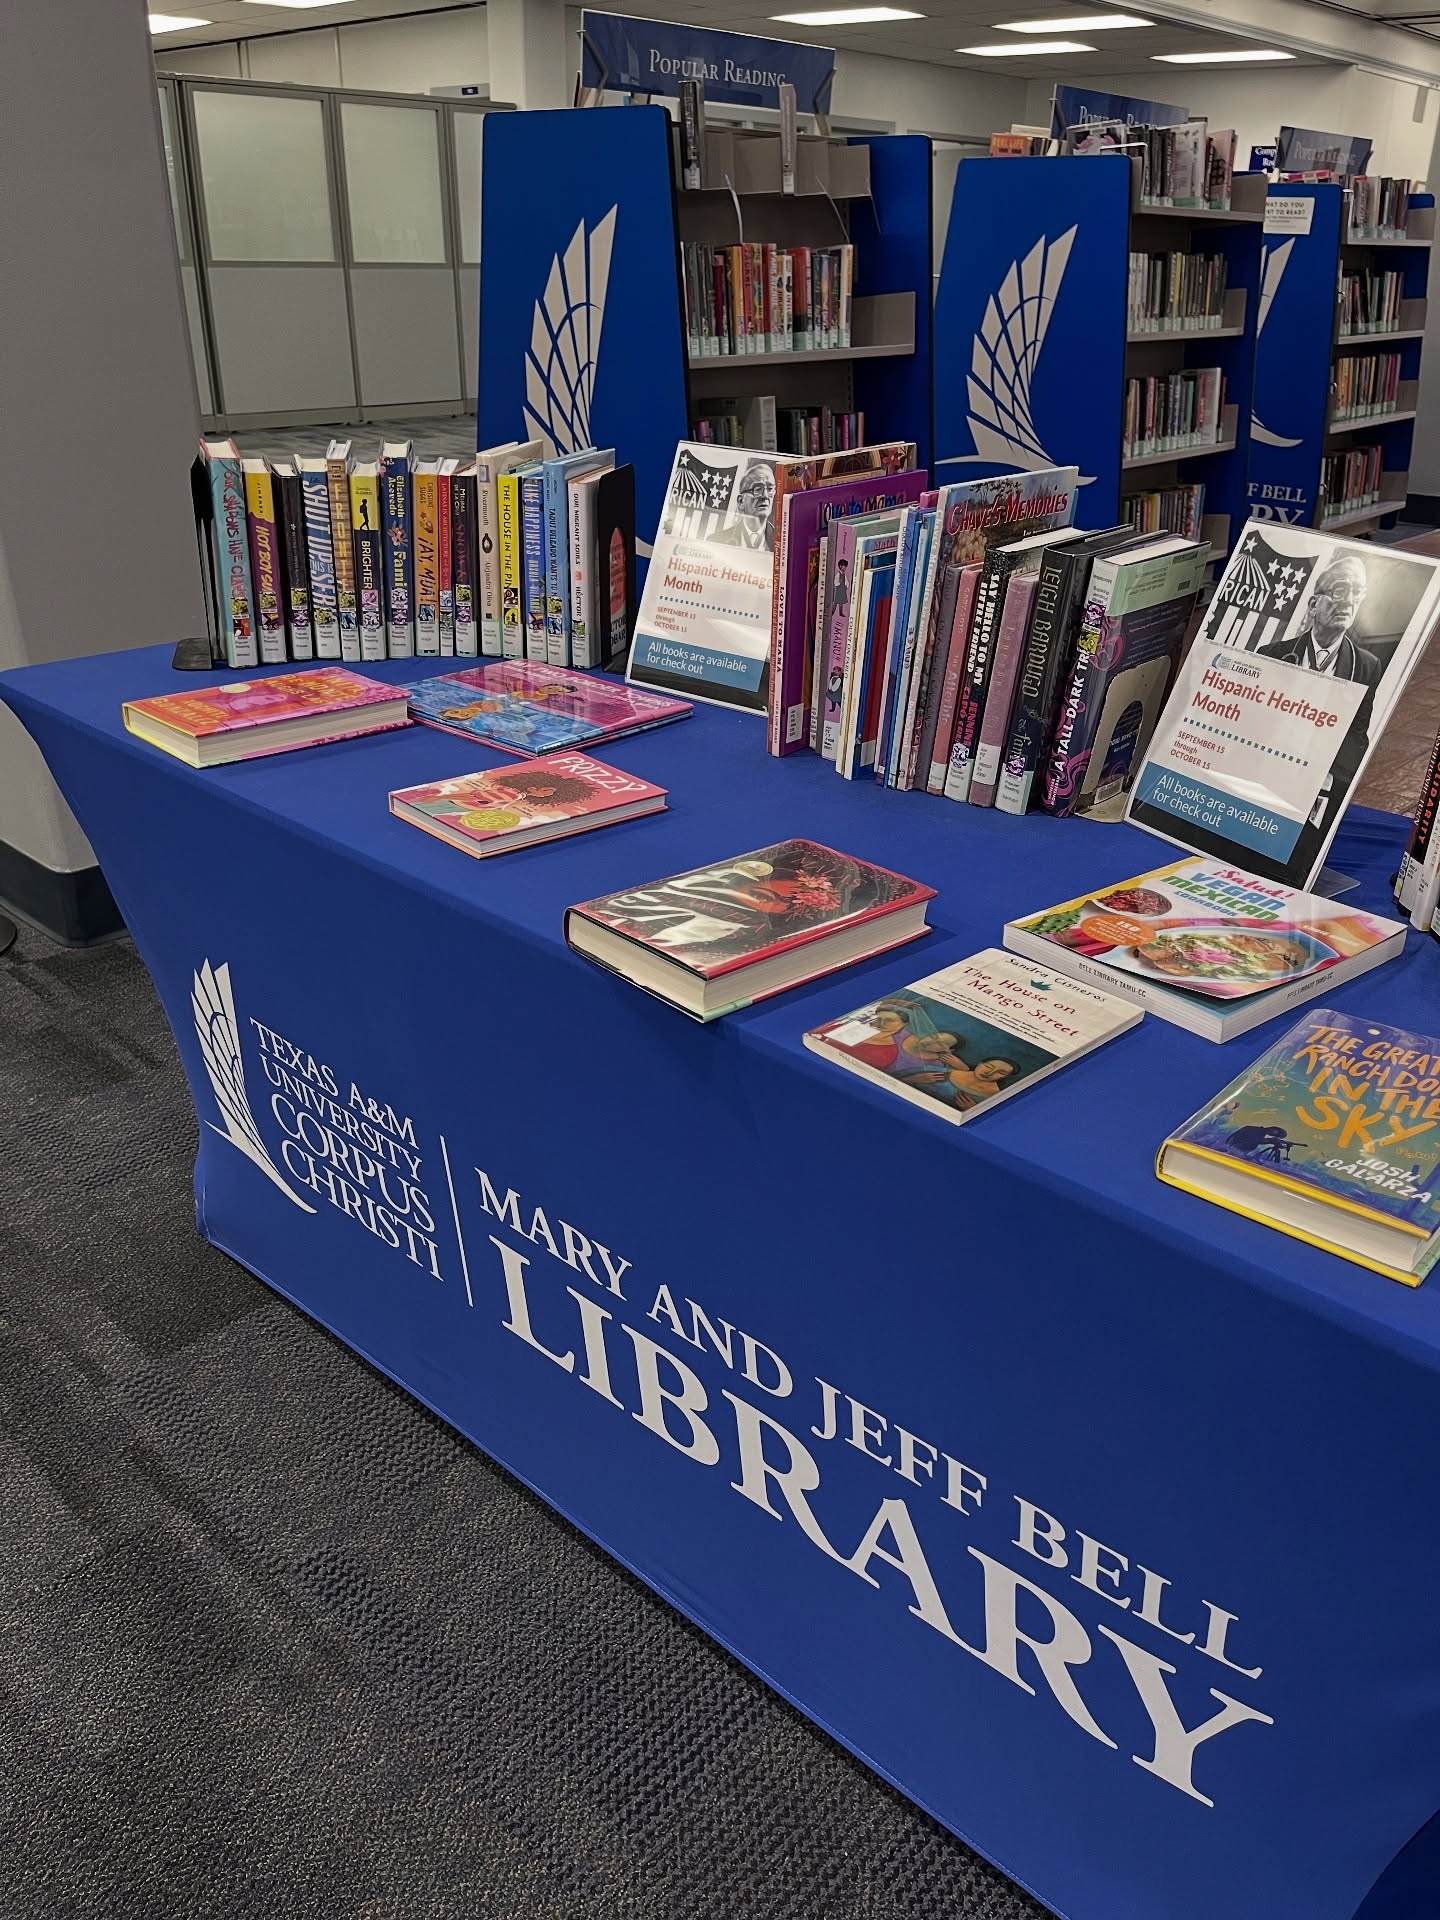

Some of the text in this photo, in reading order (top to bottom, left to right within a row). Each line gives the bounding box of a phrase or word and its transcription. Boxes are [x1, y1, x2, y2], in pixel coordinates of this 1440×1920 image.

[302, 480, 331, 534] SHUT
[389, 476, 397, 516] Acevedo
[397, 475, 405, 518] Elizabeth
[503, 484, 511, 503] THE
[1004, 489, 1069, 524] MEMORIES
[1262, 485, 1307, 503] BELL
[504, 507, 512, 540] HOUSE
[524, 507, 541, 556] HAPPINESS
[255, 526, 271, 565] HOT BOY
[361, 540, 373, 589] BRIGHTER
[504, 543, 511, 552] IN
[394, 551, 407, 588] Fami
[664, 575, 703, 594] Month
[667, 557, 772, 589] Hispanic Heritage
[658, 606, 688, 618] SEPTEMBER
[1218, 579, 1270, 613] RICAN
[654, 622, 679, 631] OCTOBER
[779, 622, 784, 636] TO
[965, 582, 989, 673] LITTLE FRIEND
[973, 573, 1000, 687] SAY HELLO TO MY
[1022, 564, 1062, 698] LEIGH BARDUGO
[647, 652, 703, 674] for check out
[648, 642, 747, 672] All books are available
[1231, 664, 1262, 678] LIBRARY
[1192, 692, 1241, 721] Month
[1201, 669, 1338, 728] Hispanic Heritage
[1055, 676, 1085, 771] A TALL DARK
[1177, 730, 1225, 754] SEPTEMBER 15
[1170, 749, 1210, 770] OCTOBER 15
[1174, 740, 1198, 755] through
[547, 756, 648, 794] FRIZZY
[1153, 788, 1222, 827] for check out
[1157, 775, 1279, 835] All books are available
[1160, 876, 1280, 921] MEXICAN
[1190, 872, 1287, 910] VEGAN
[1211, 869, 1295, 900] ¡Salud!
[963, 965, 1076, 1016] The House on
[1005, 956, 1107, 1003] Sandra Cisneros
[1079, 962, 1095, 974] BELL
[1093, 970, 1119, 987] LIBRARY
[967, 979, 1024, 1010] Mango
[1030, 1008, 1080, 1038] Street
[1293, 1044, 1390, 1086] RANCH
[1305, 1024, 1440, 1075] THE GREAT
[250, 1016, 419, 1150] TEXAS A&M
[1309, 1067, 1440, 1120] IN THE
[259, 1053, 422, 1183] UNIVERSITY
[1295, 1095, 1438, 1154] SKY
[271, 1093, 435, 1232] CORPUS
[1324, 1157, 1432, 1204] GALARZA
[1356, 1157, 1421, 1183] JOSH
[281, 1139, 444, 1282] CHRISTI
[474, 1166, 1263, 1679] MARY AND JEFF BELL
[488, 1234, 1274, 1808] LIBRARY
